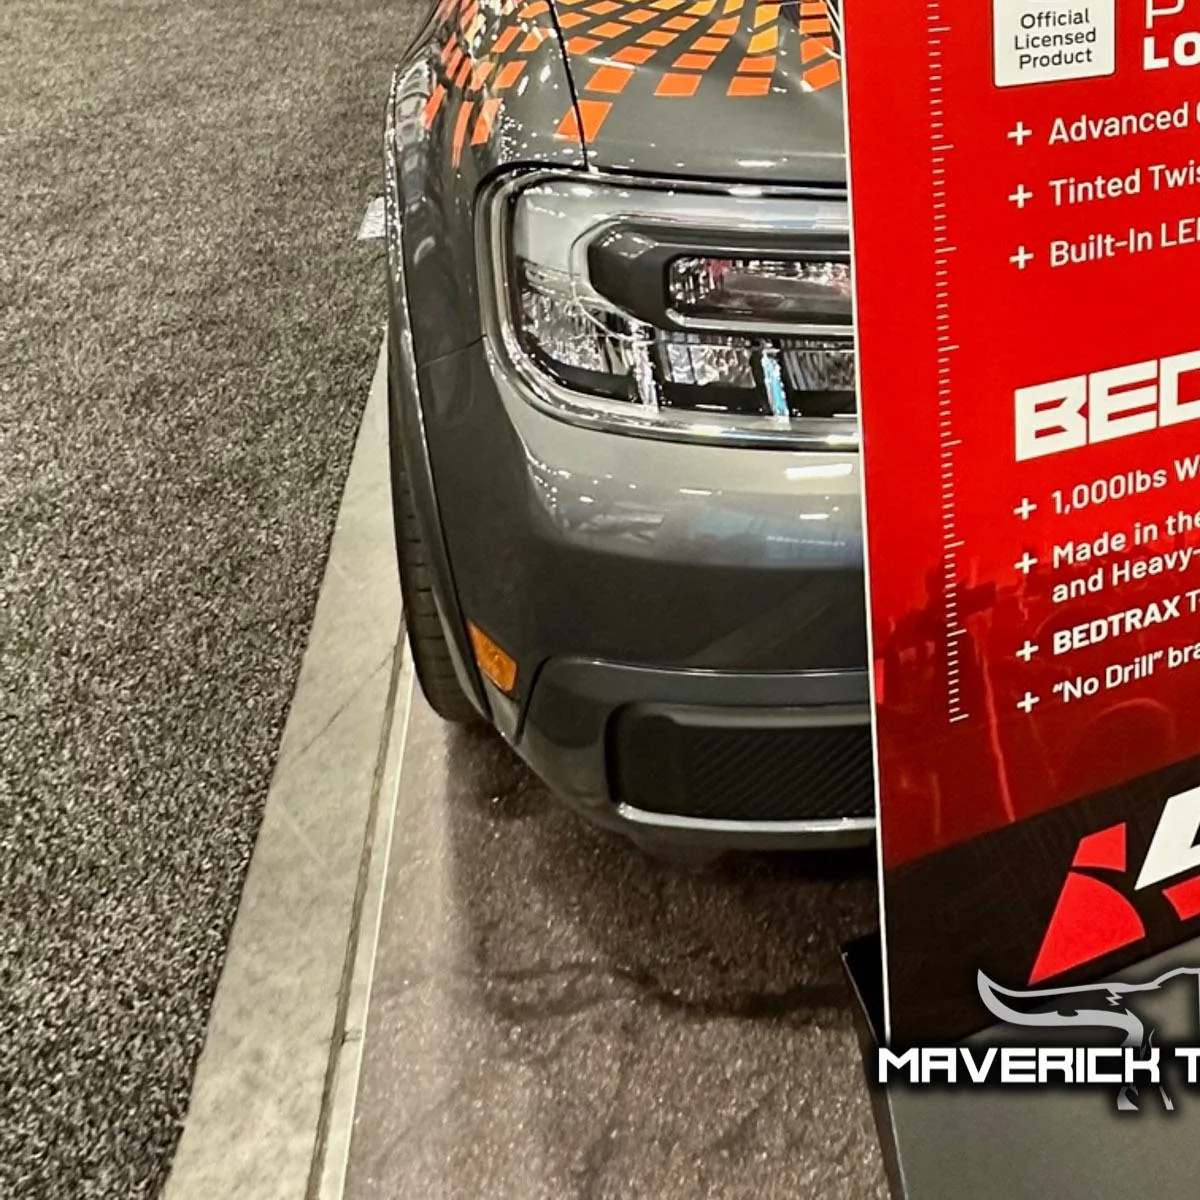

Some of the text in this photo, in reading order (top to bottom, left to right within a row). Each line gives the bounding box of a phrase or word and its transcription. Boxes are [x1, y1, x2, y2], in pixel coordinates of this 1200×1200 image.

[1020, 8, 1091, 30] Official
[1014, 28, 1097, 51] Licensed
[1019, 48, 1093, 70] Product
[1048, 102, 1189, 145] Advanced
[1049, 168, 1141, 206] Tinted
[1050, 228, 1153, 268] Built-In
[1052, 468, 1168, 515] 1,000lbs
[1053, 531, 1126, 569] Made
[1134, 522, 1158, 545] in
[1052, 568, 1104, 603] and
[1053, 596, 1181, 655] BEDTRAX
